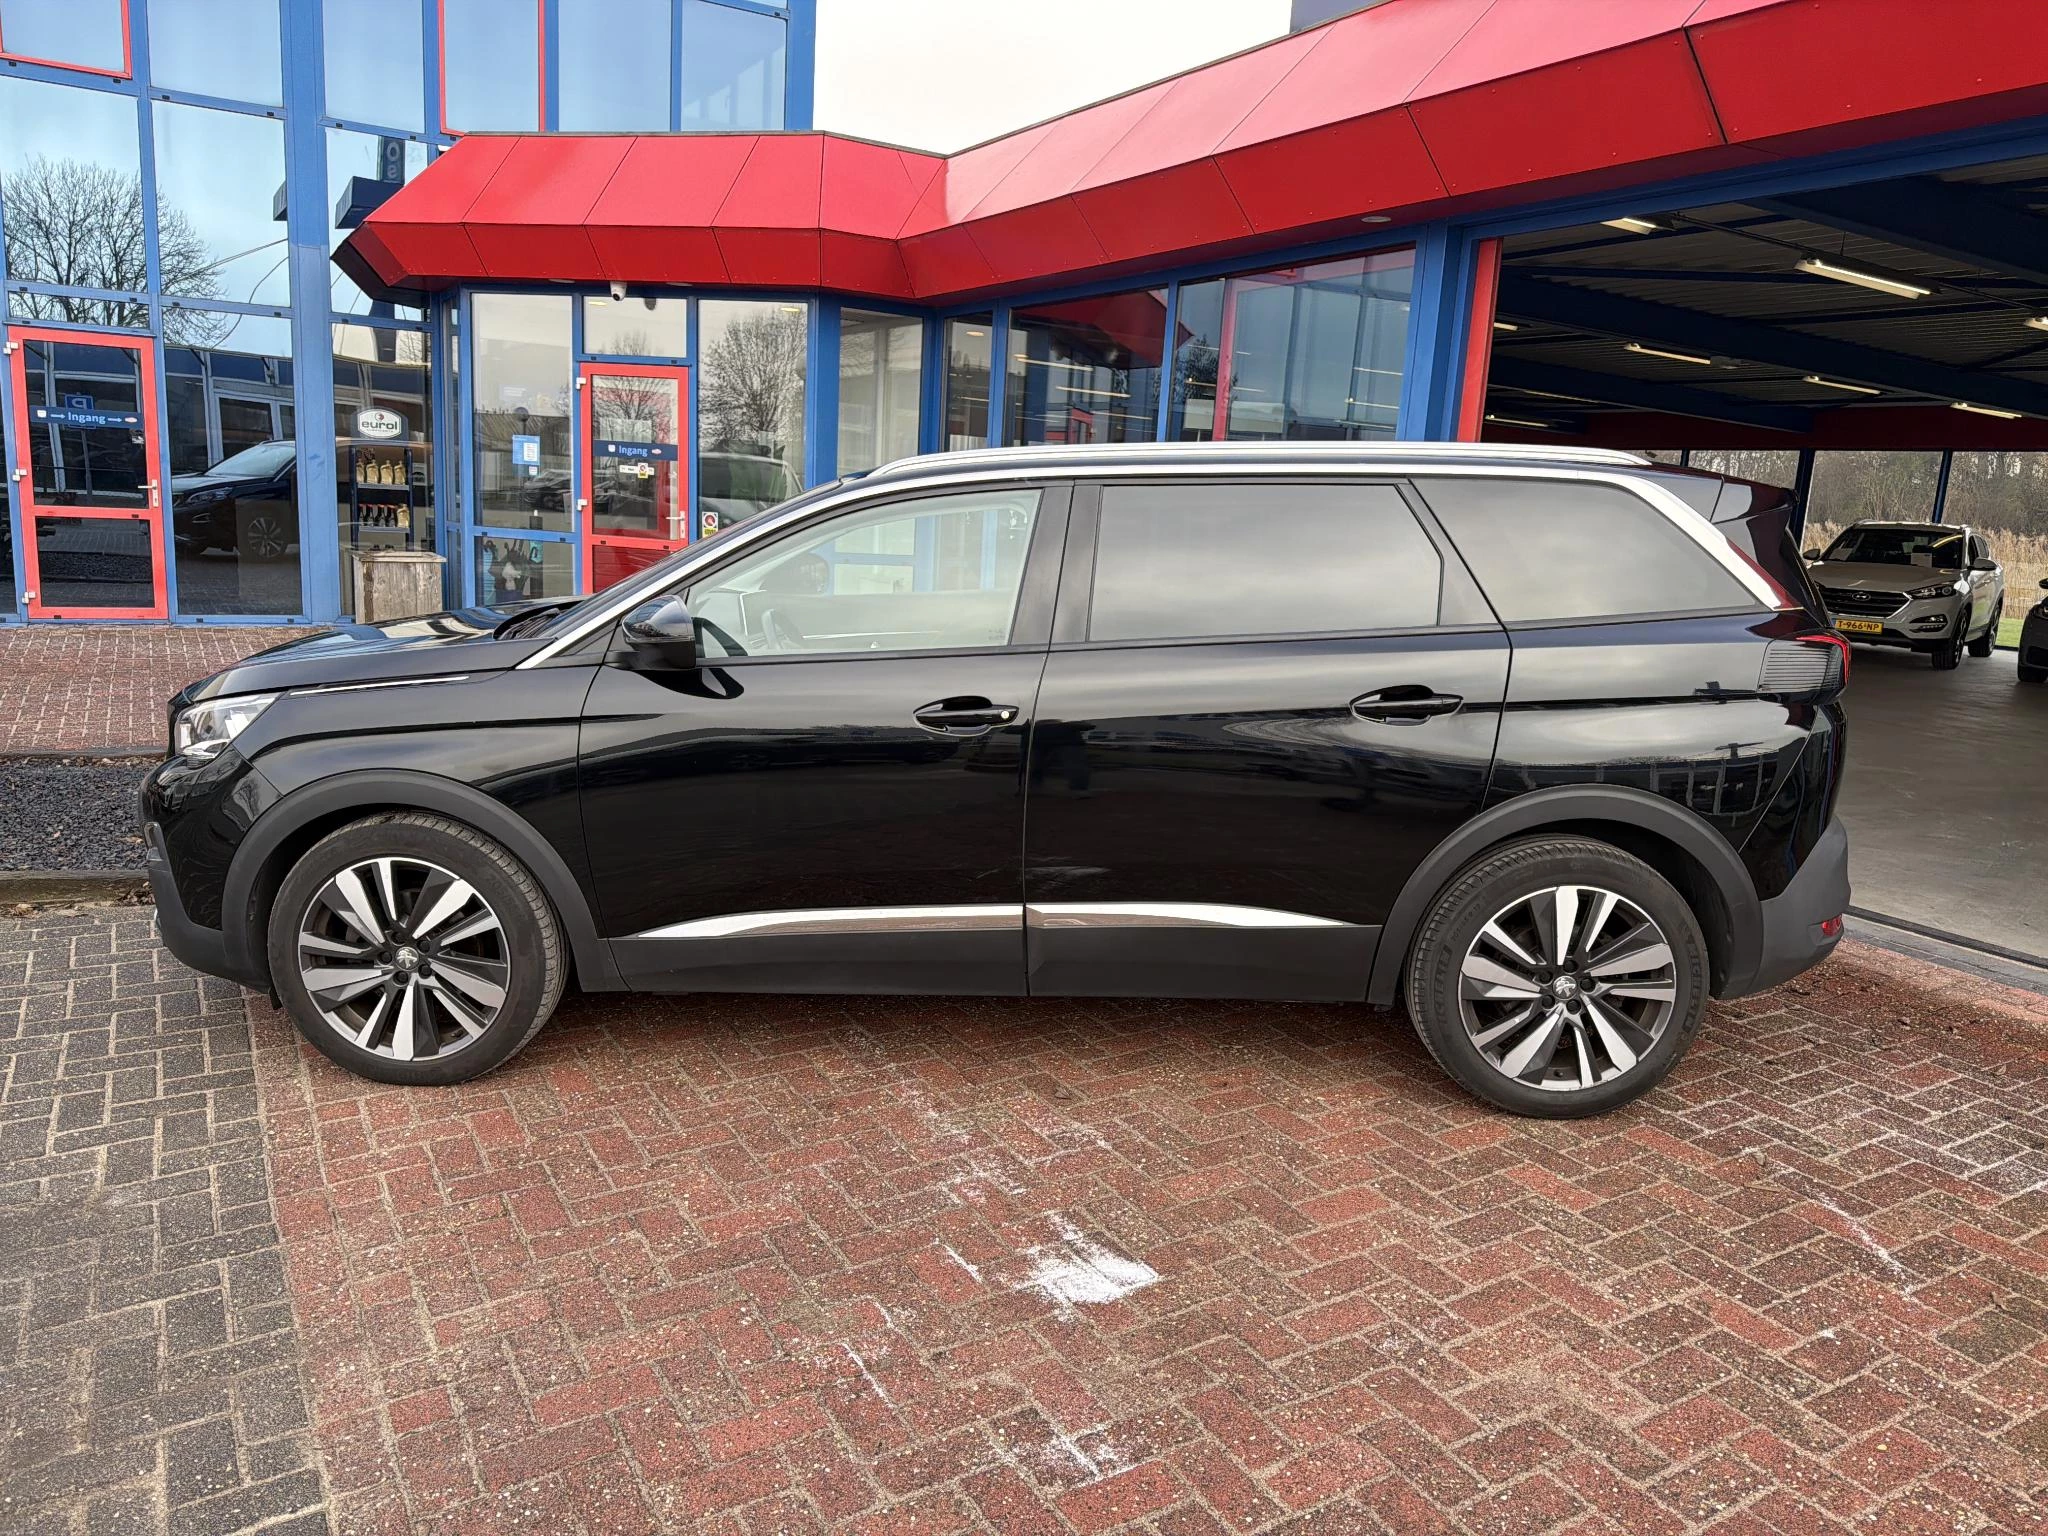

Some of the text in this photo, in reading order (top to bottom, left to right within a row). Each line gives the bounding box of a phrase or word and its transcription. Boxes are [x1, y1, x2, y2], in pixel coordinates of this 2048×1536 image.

[68, 412, 106, 424] Ingang
[361, 421, 398, 430] eurol
[618, 445, 648, 457] Ingang
